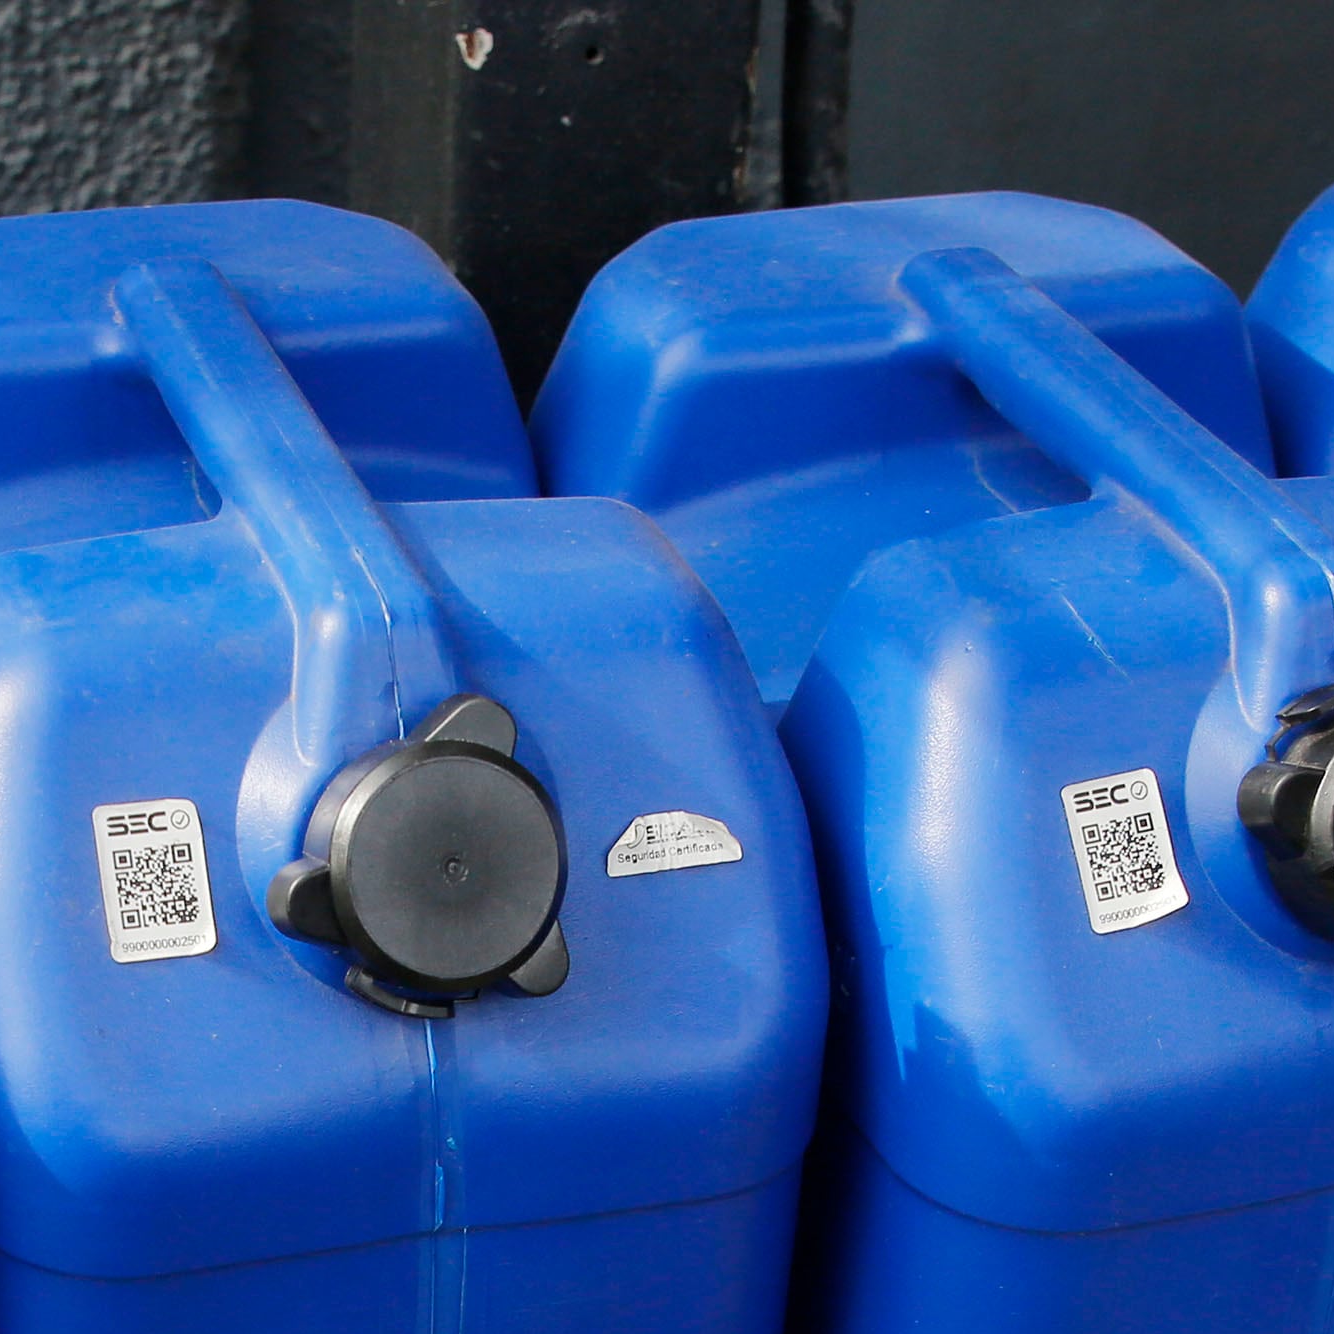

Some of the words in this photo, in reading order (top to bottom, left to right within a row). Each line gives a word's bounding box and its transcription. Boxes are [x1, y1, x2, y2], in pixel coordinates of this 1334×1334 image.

[1073, 784, 1129, 813] SEC
[107, 811, 168, 836] SEC
[617, 847, 666, 864] Seguridad
[668, 842, 724, 856] Certificada
